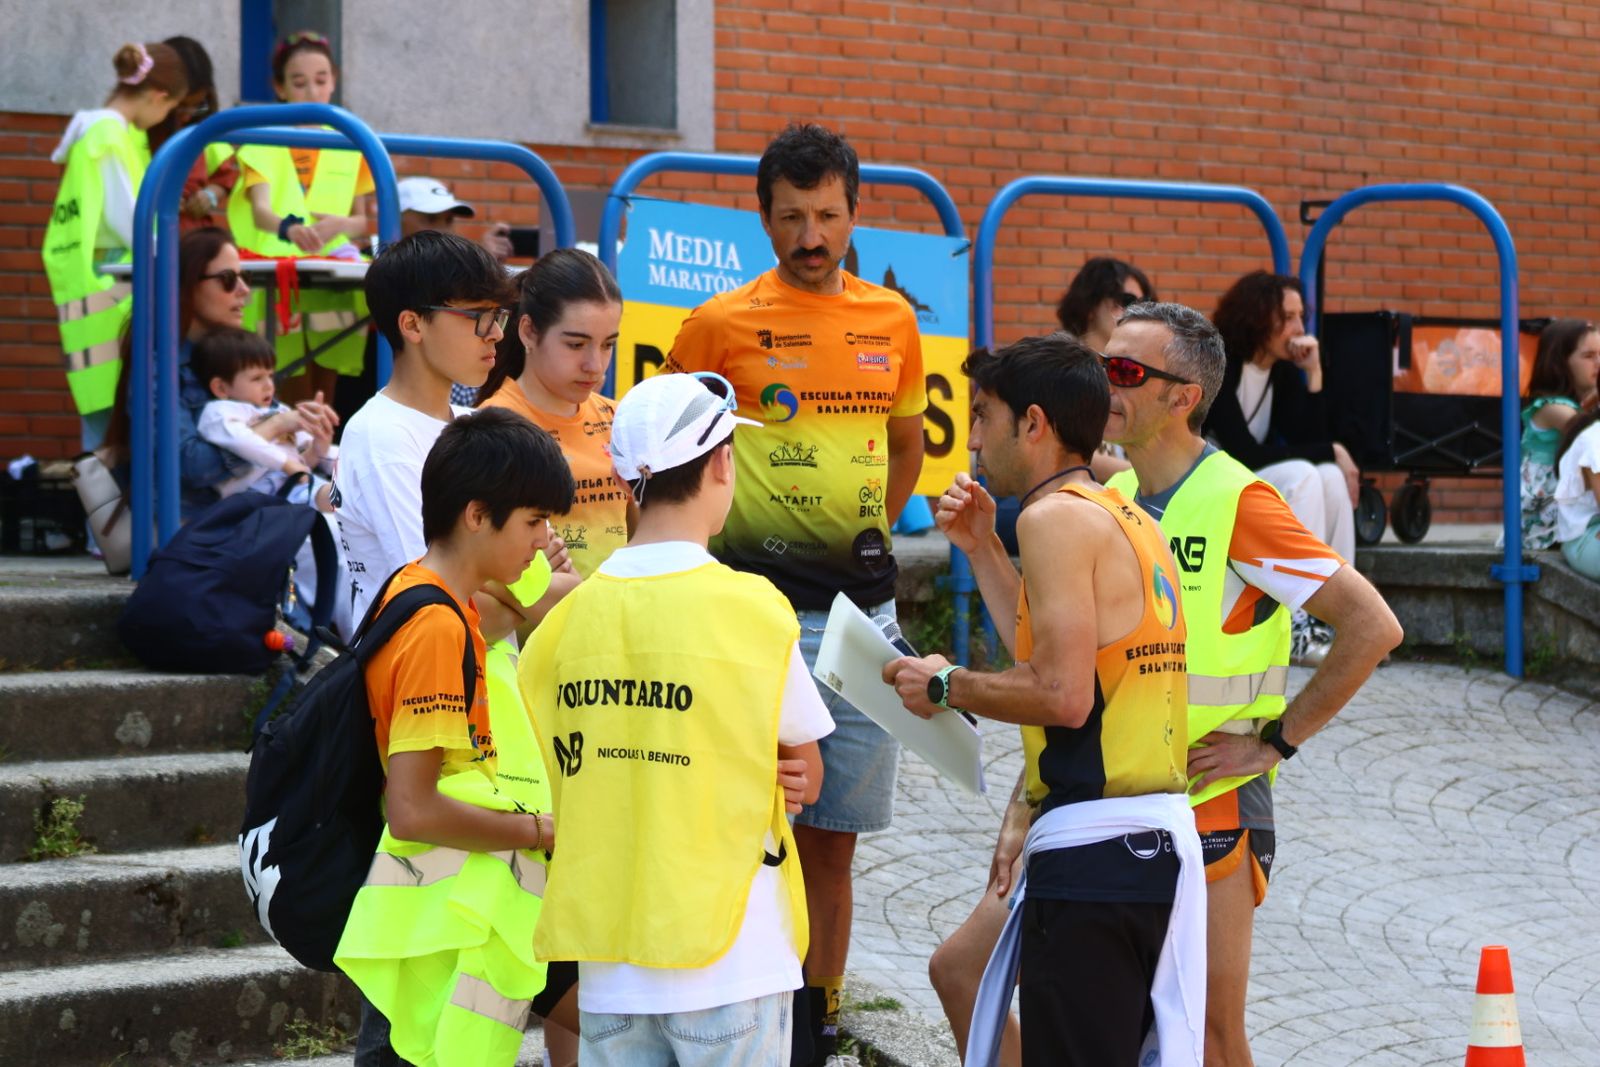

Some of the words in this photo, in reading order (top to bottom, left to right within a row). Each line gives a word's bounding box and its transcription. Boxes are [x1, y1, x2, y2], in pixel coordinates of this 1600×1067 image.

[648, 228, 742, 272] MEDIA
[648, 263, 743, 293] MARATÓN
[800, 391, 852, 401] ESCUELA
[855, 391, 895, 402] TRIATL
[576, 478, 603, 490] UELA
[573, 492, 627, 504] ALMANT
[769, 494, 823, 506] ALTAFIT
[438, 692, 464, 702] TRIAT
[413, 703, 464, 715] SALANTIN
[648, 750, 691, 767] BENITO
